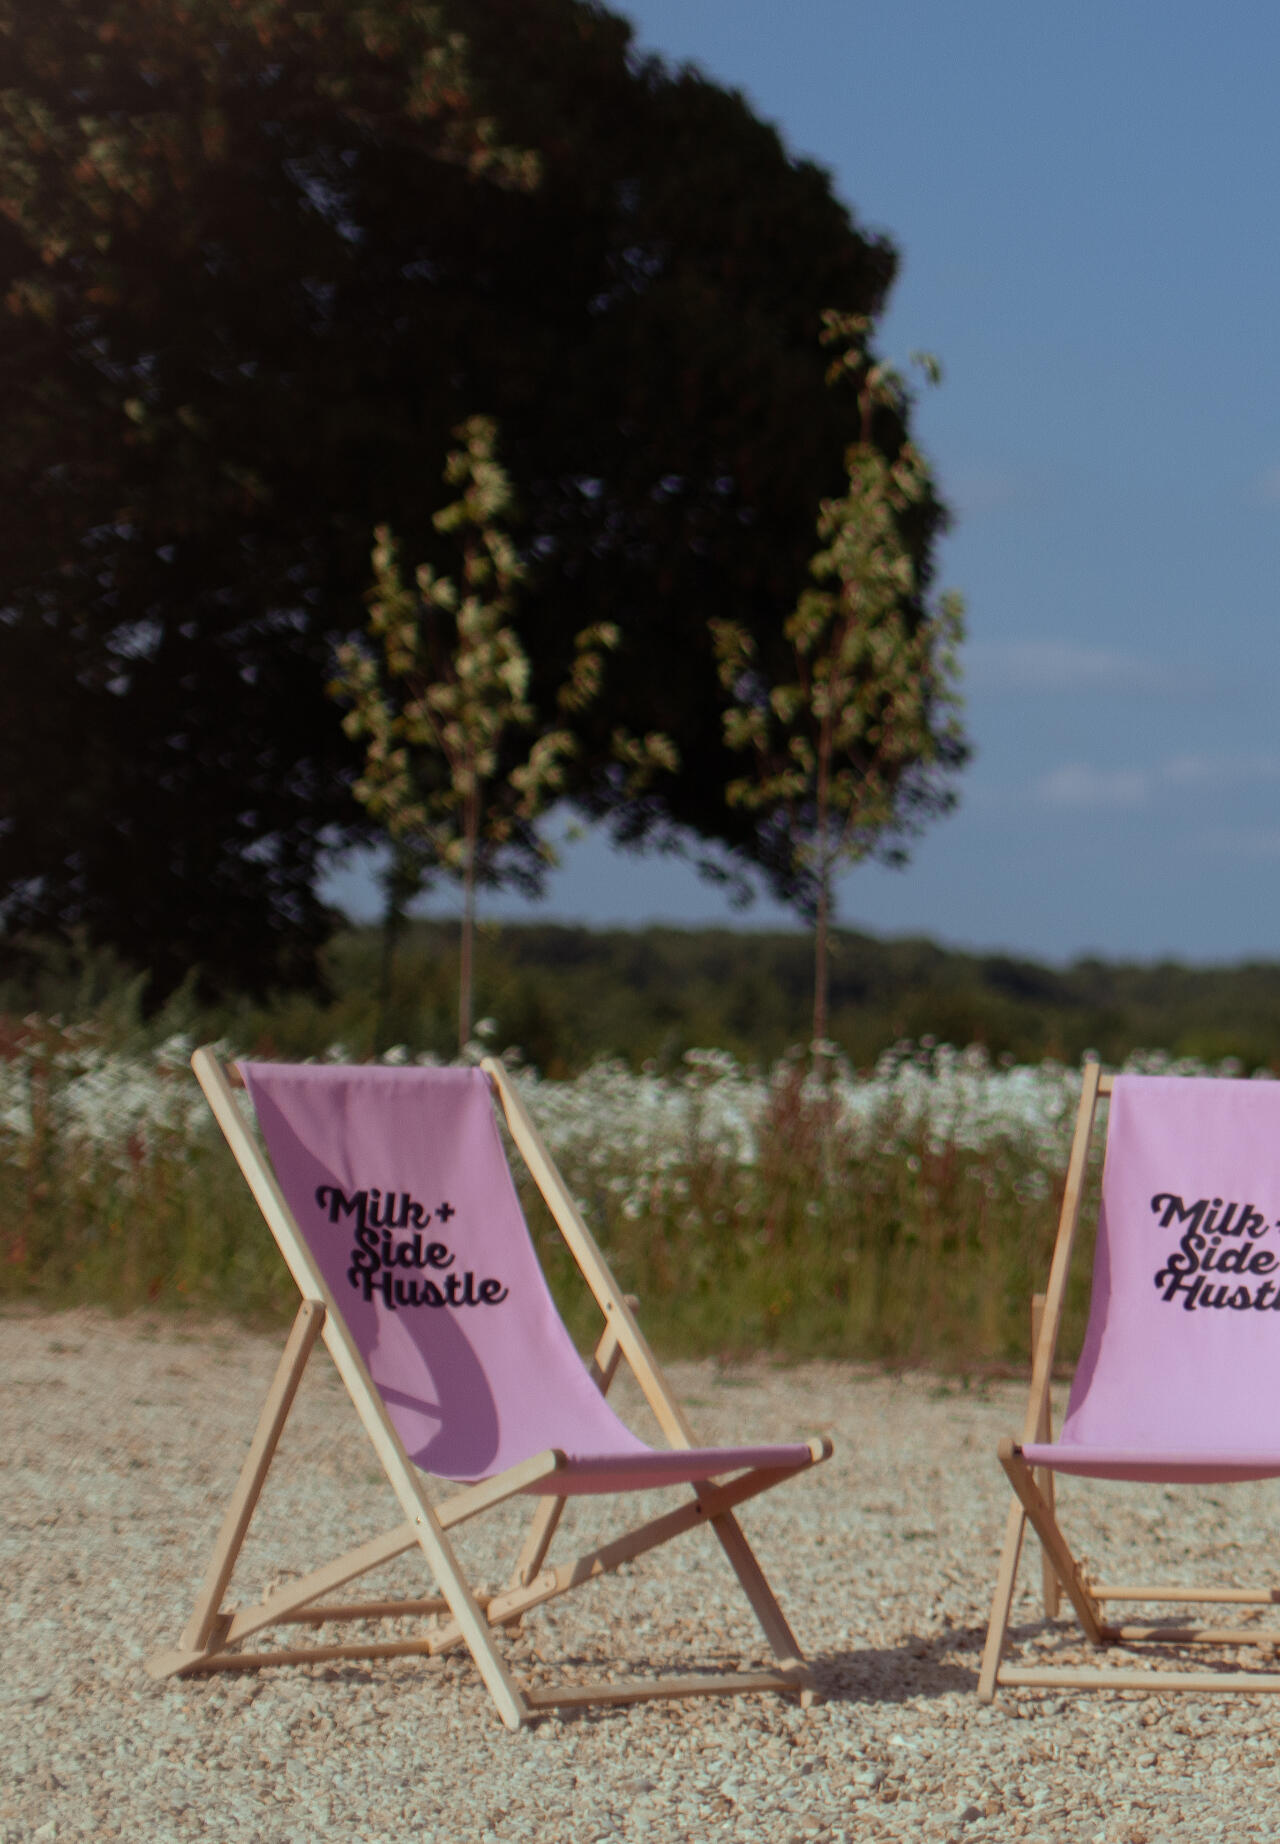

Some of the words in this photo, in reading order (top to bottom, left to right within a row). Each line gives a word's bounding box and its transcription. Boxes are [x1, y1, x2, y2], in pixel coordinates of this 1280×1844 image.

[315, 1185, 431, 1229] Milk
[435, 1202, 455, 1223] +
[1151, 1193, 1269, 1239] Milk
[351, 1226, 455, 1271] Side
[1167, 1233, 1280, 1276] Side
[347, 1267, 509, 1310] Hustle
